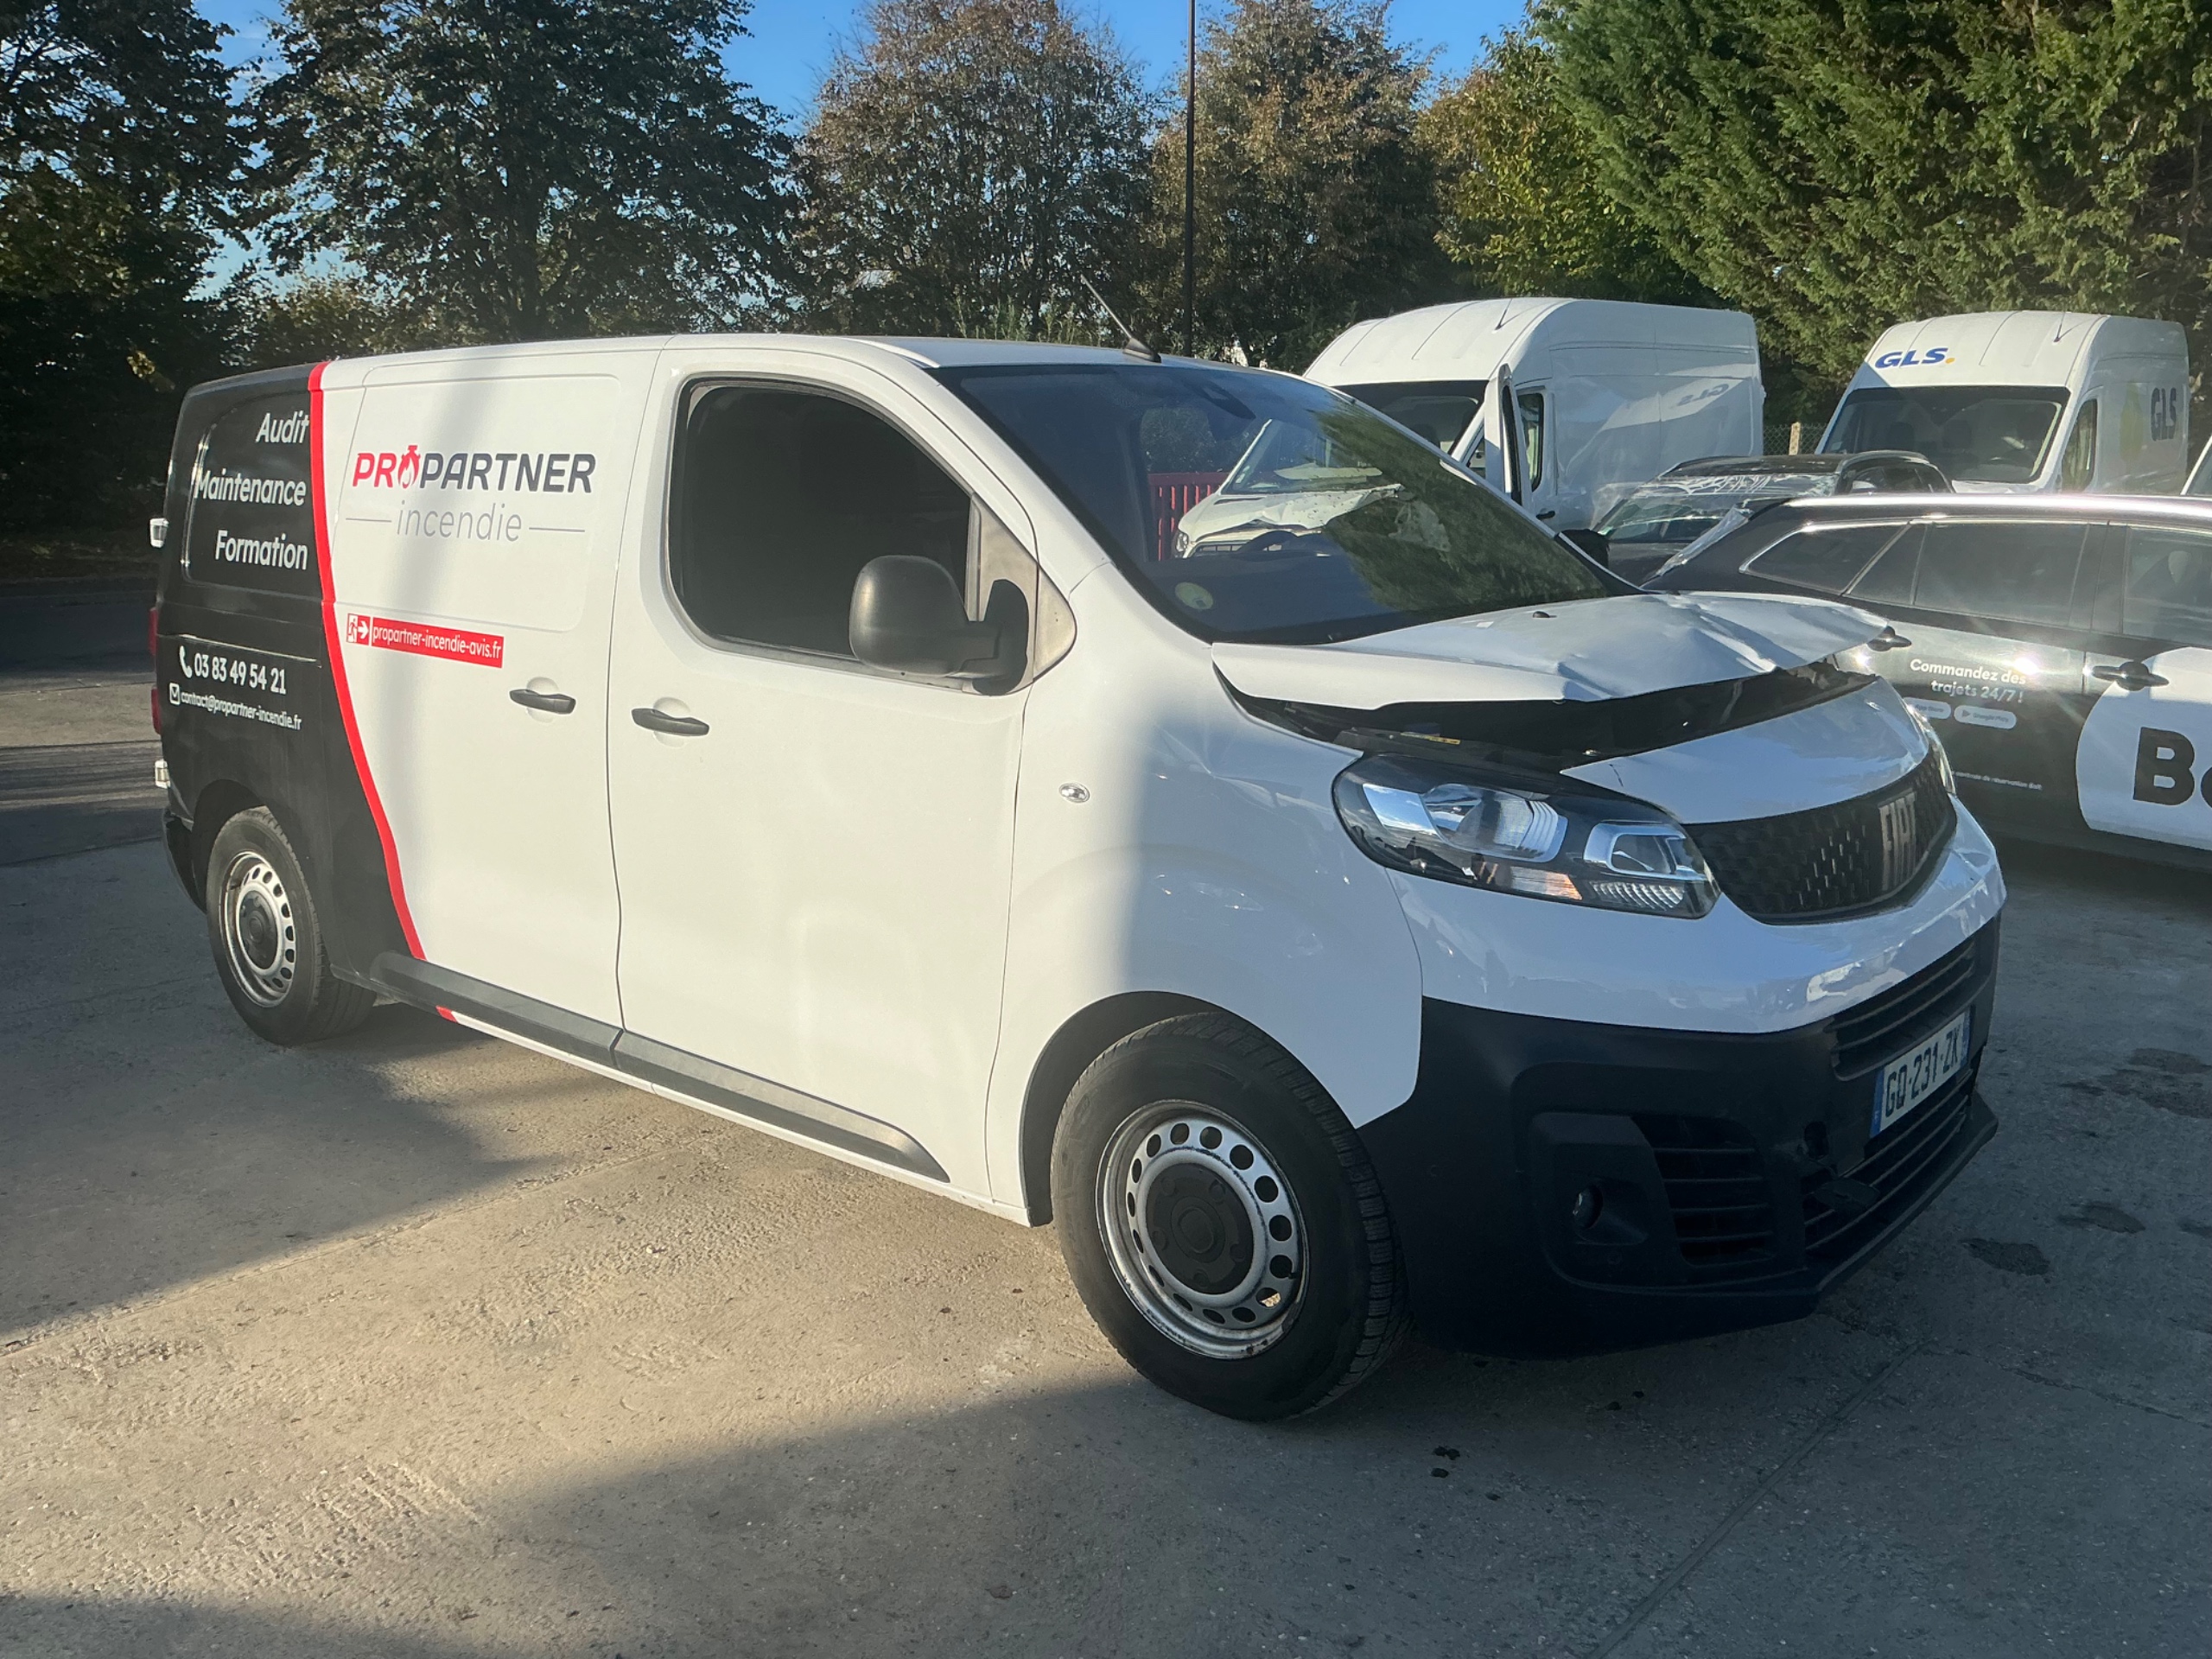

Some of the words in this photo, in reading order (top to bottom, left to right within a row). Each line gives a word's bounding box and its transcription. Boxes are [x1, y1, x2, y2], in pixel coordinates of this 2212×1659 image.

[255, 410, 310, 443] Audit
[2151, 387, 2177, 442] GLS
[194, 467, 307, 506] Maintenance
[397, 499, 522, 542] incendie
[215, 529, 308, 570] Formation
[372, 626, 502, 659] propartner-incendie-avis.fr
[194, 652, 210, 678] 03
[211, 657, 227, 683] 83
[229, 659, 247, 687] 49
[249, 663, 268, 691] 54
[270, 667, 287, 695] 21
[1910, 658, 1998, 682] Commandez
[2000, 671, 2027, 685] des
[1930, 679, 1977, 697] trajets
[1980, 685, 2017, 702] 24/7
[181, 692, 302, 731] contact@propartner-incendie.fr
